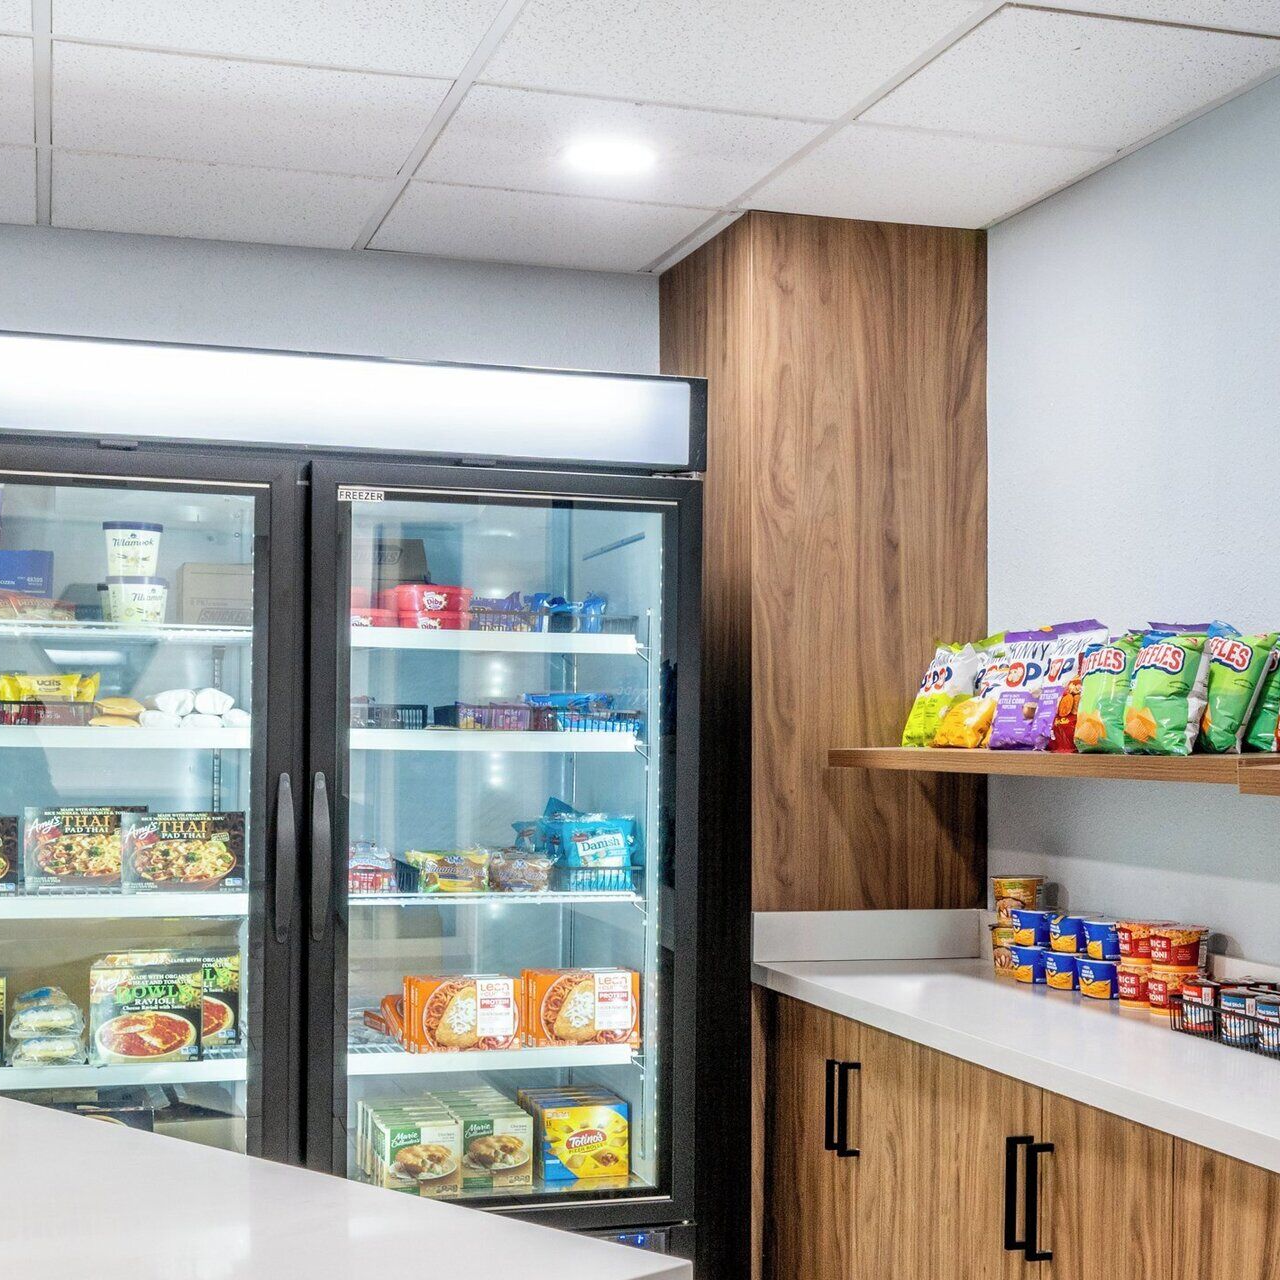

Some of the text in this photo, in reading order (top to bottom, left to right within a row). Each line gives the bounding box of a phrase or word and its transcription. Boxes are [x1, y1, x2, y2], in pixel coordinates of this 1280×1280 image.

[339, 492, 383, 500] FREEZER
[113, 538, 153, 547] Tillamook
[28, 816, 60, 837] Amy's
[62, 816, 110, 827] THAI
[159, 821, 207, 832] THAI
[125, 822, 158, 843] Amy's
[582, 836, 620, 852] Danish
[116, 985, 192, 1004] BOWLS
[469, 1124, 490, 1132] Marie
[396, 1132, 418, 1140] Marie
[568, 1132, 604, 1147] Totino's
